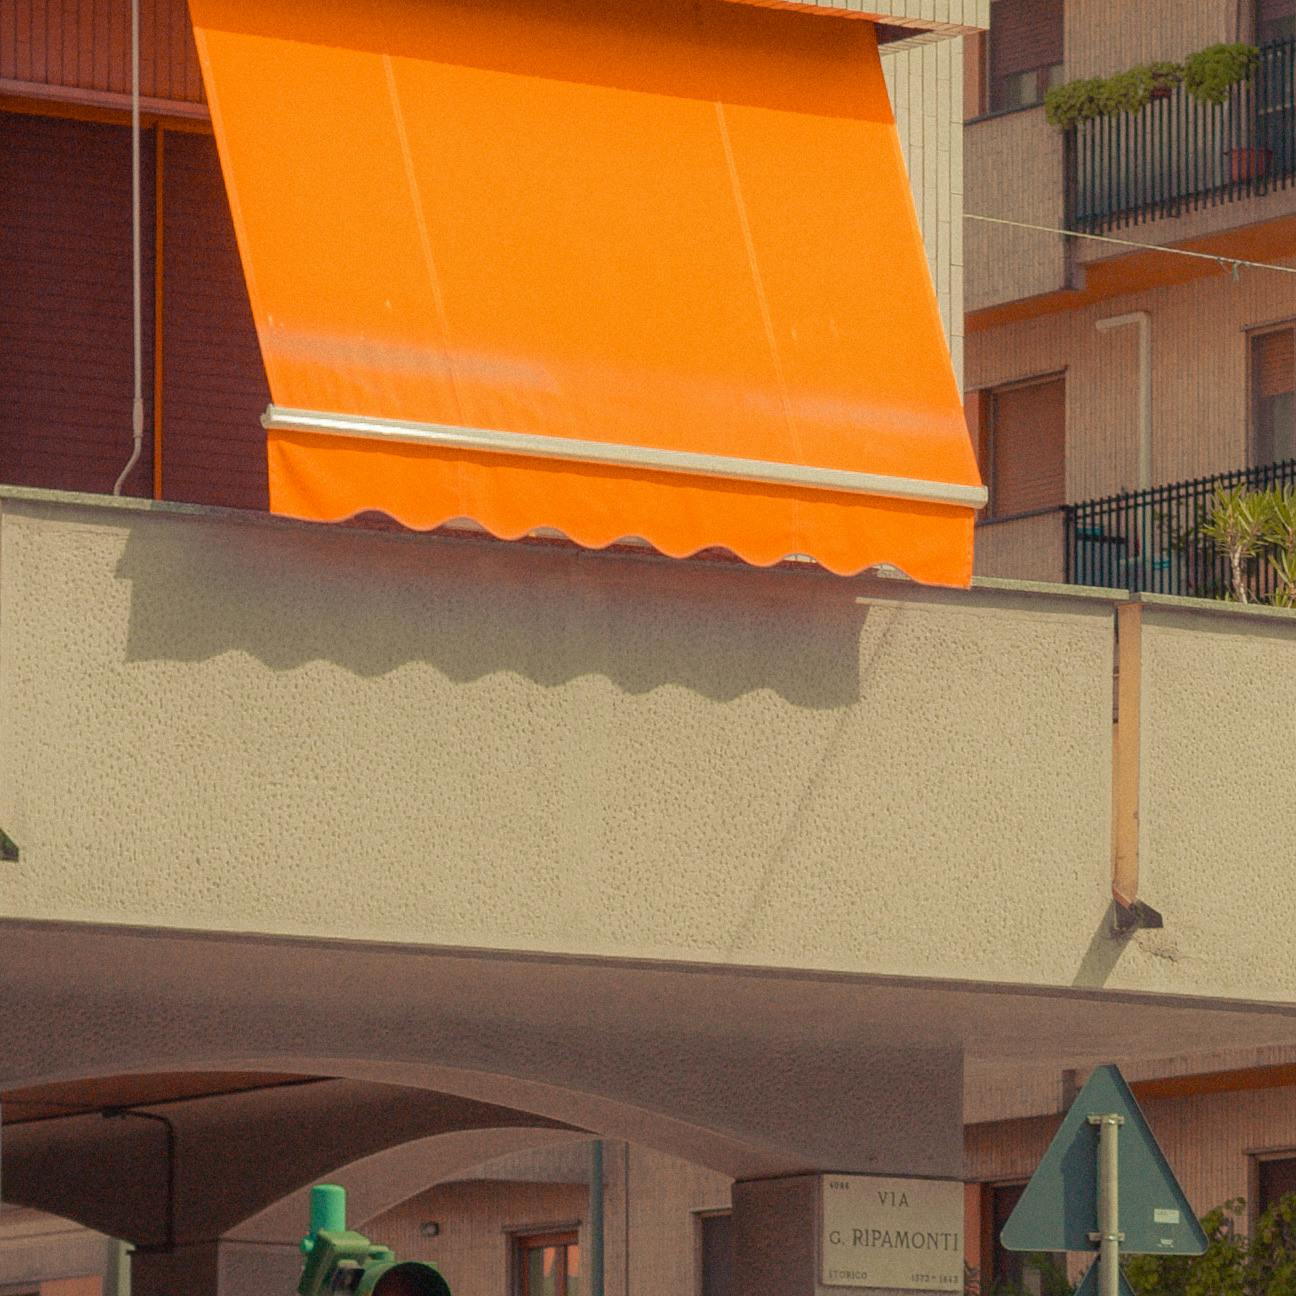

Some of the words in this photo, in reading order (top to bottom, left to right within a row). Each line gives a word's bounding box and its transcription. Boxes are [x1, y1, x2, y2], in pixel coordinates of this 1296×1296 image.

[877, 1191, 909, 1207] VIA
[829, 1230, 846, 1246] G.
[852, 1228, 959, 1252] RIPAMONTI
[828, 1269, 868, 1280] STORICO
